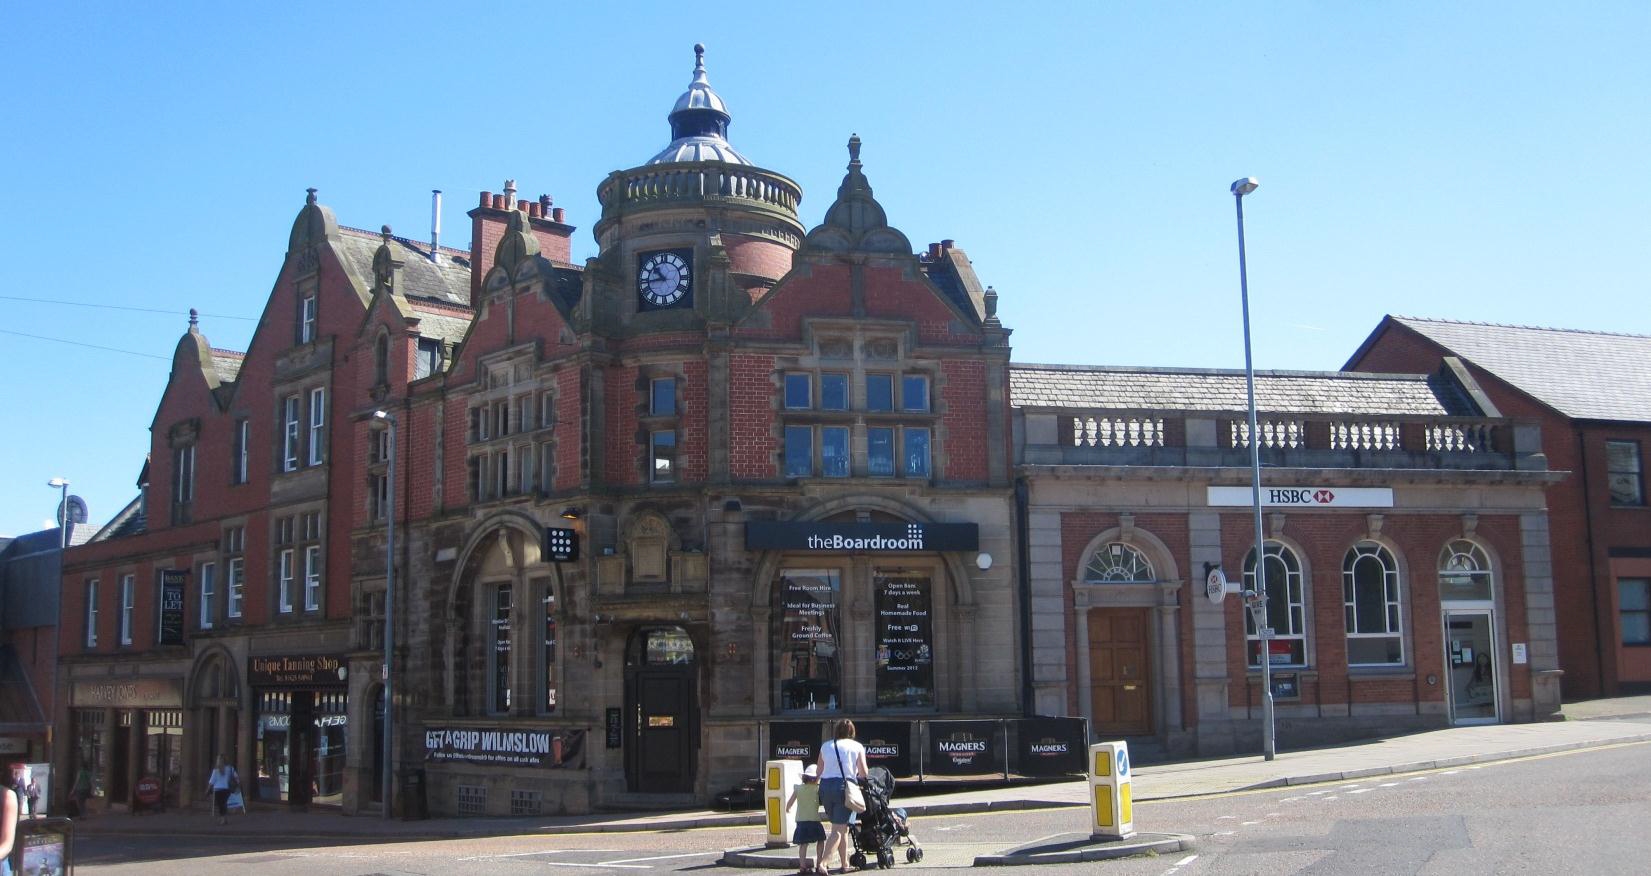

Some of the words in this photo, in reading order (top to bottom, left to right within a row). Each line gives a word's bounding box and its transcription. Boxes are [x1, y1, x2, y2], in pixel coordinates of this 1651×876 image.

[1269, 489, 1311, 504] HSBC
[808, 534, 923, 549] theBoardroom
[1208, 583, 1222, 594] HSBC
[166, 591, 182, 601] TO
[164, 600, 184, 610] LET
[798, 609, 825, 617] Meetings
[801, 625, 822, 633] Freshly
[254, 658, 282, 674] Unique
[282, 656, 316, 674] Tanning
[317, 656, 339, 674] Shop
[445, 731, 453, 745] A
[452, 731, 480, 750] GRIP
[482, 732, 549, 753] WILMSLOW
[939, 741, 986, 751] MAGNERS
[777, 747, 808, 755] MAGNERS
[1031, 743, 1067, 753] MAGNERS
